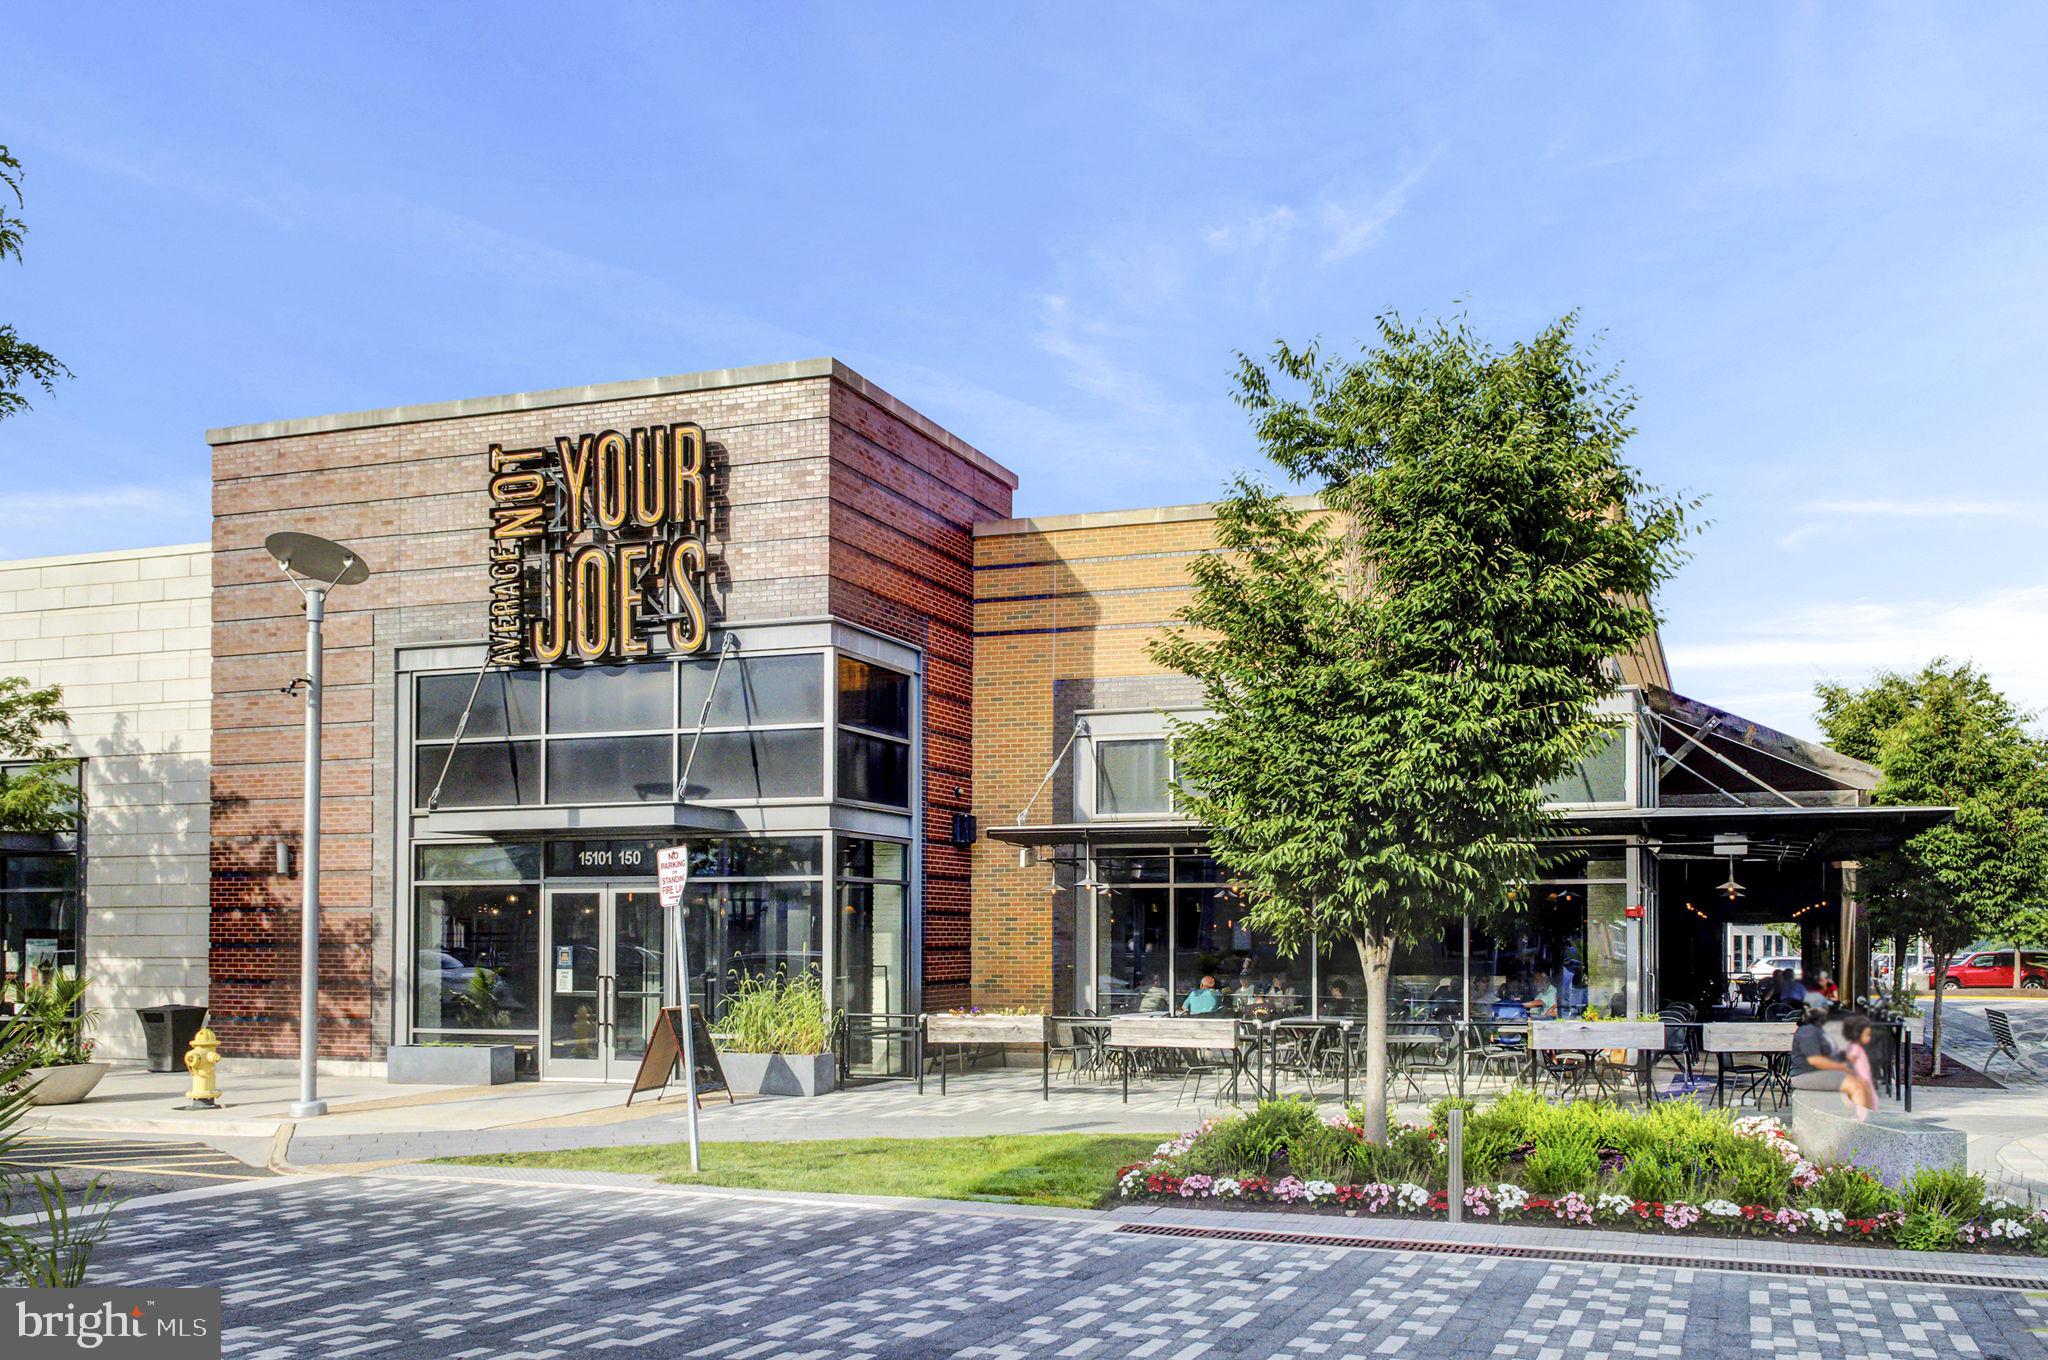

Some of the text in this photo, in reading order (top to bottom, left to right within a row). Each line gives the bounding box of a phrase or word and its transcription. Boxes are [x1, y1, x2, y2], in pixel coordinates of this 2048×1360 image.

[554, 422, 706, 532] YOUR
[487, 443, 546, 539] NOT
[488, 546, 525, 666] AVERAGE
[529, 536, 707, 662] JOE'S
[579, 851, 641, 865] 15101 150
[668, 851, 678, 860] NO
[660, 860, 686, 869] PARKING
[662, 875, 685, 884] STANDIN
[662, 885, 674, 895] FIRE
